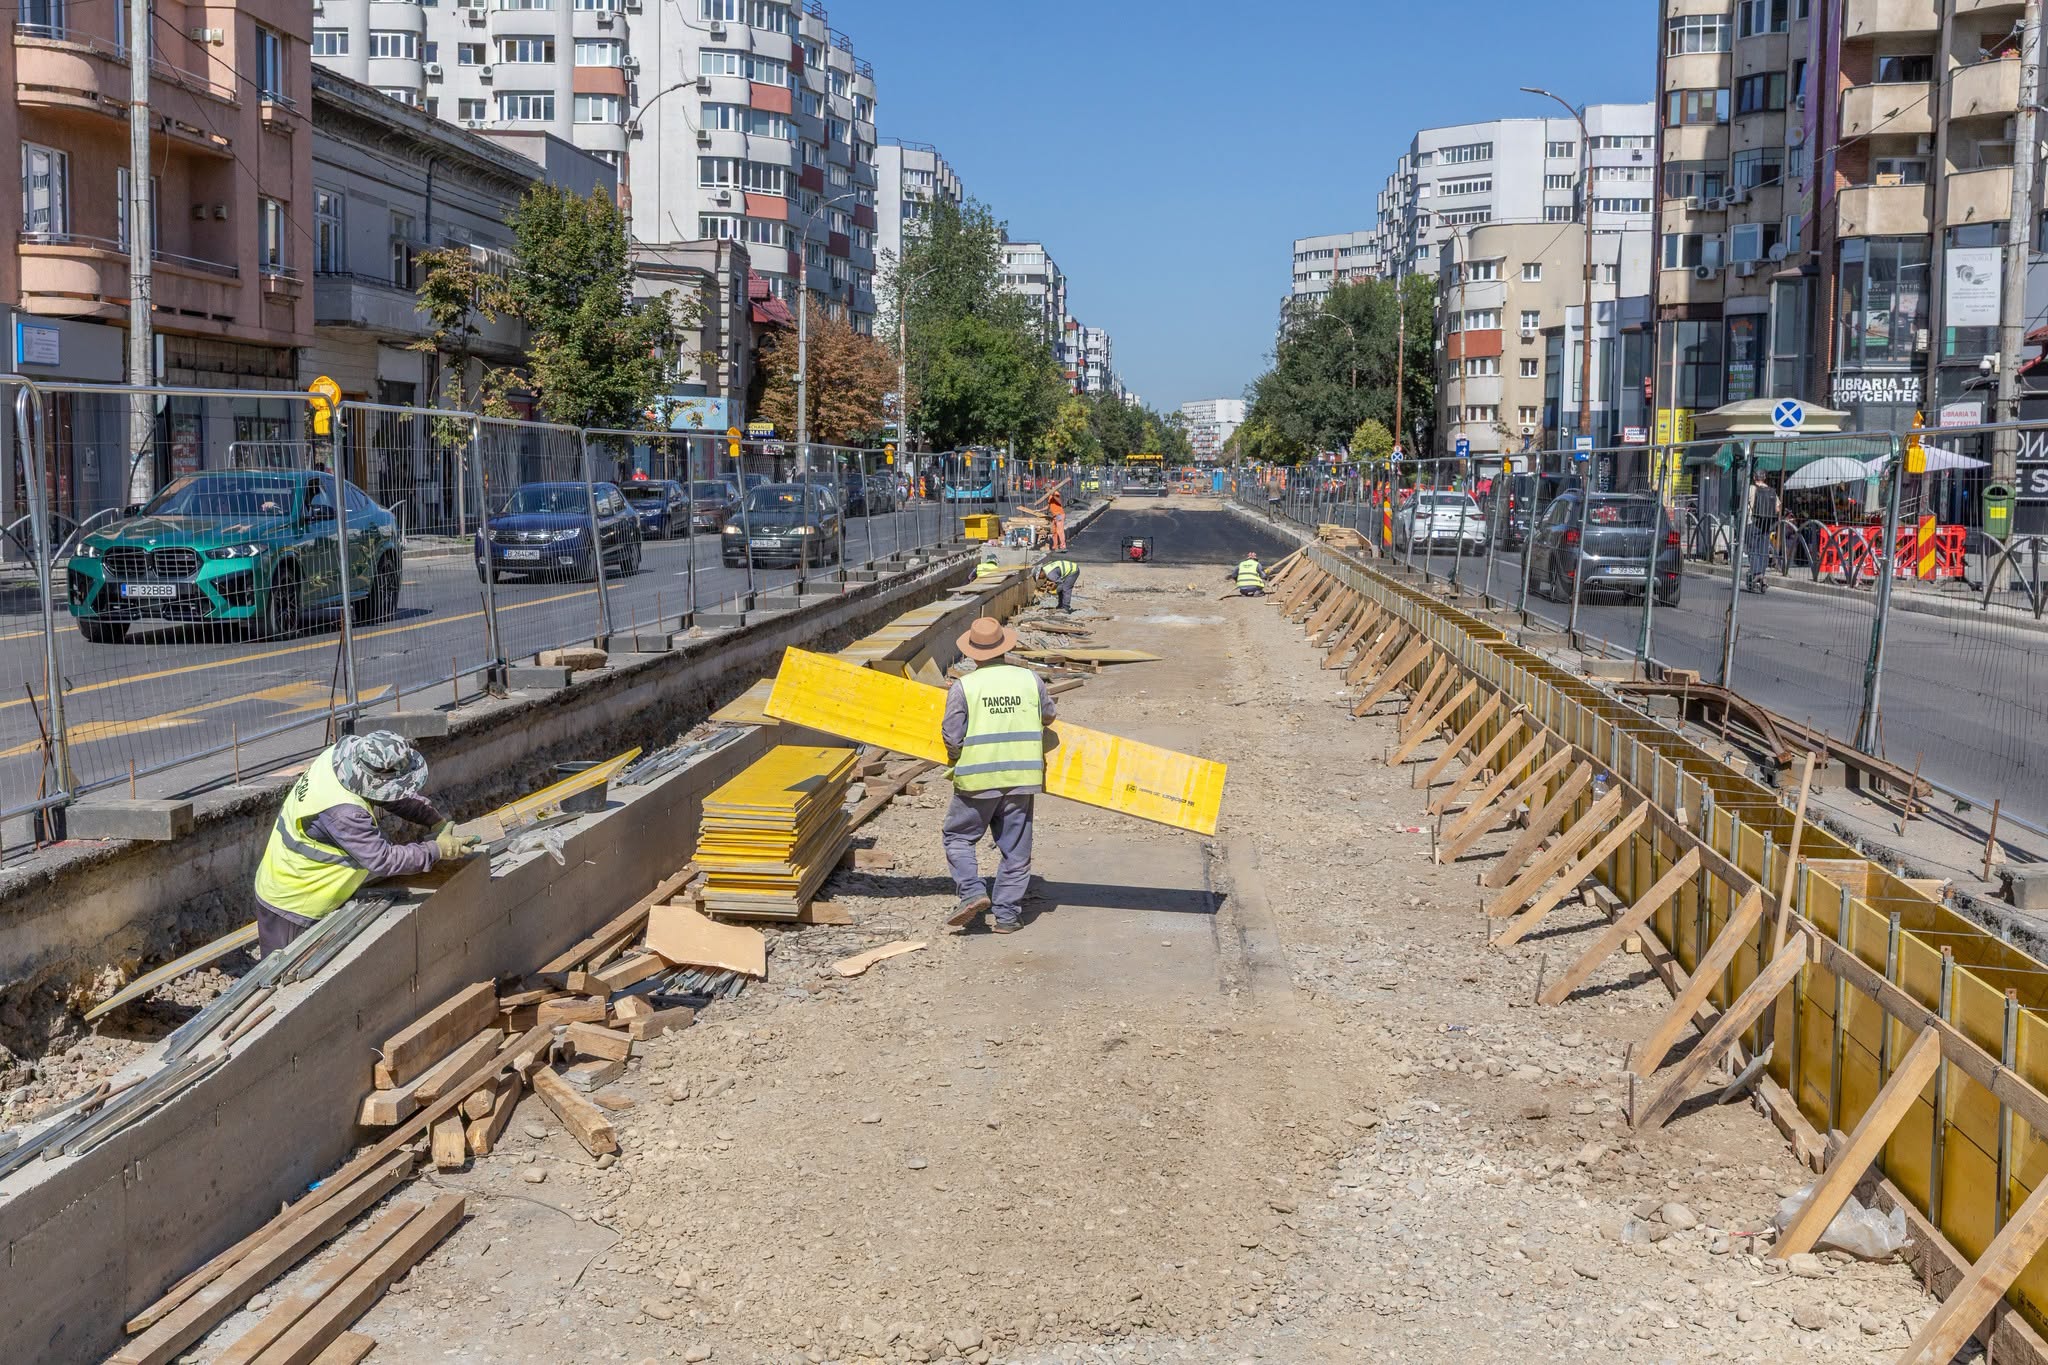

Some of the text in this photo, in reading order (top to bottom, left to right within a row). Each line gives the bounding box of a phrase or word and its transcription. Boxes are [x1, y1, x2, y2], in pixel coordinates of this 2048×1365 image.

[1833, 377, 1920, 391] LIBRARIA TA
[1833, 390, 1920, 403] COPYCENTER
[1942, 410, 1969, 418] LIBRARIA
[140, 585, 173, 595] 32BBB
[982, 695, 1022, 707] TANCRAD
[989, 706, 1015, 715] GALATI
